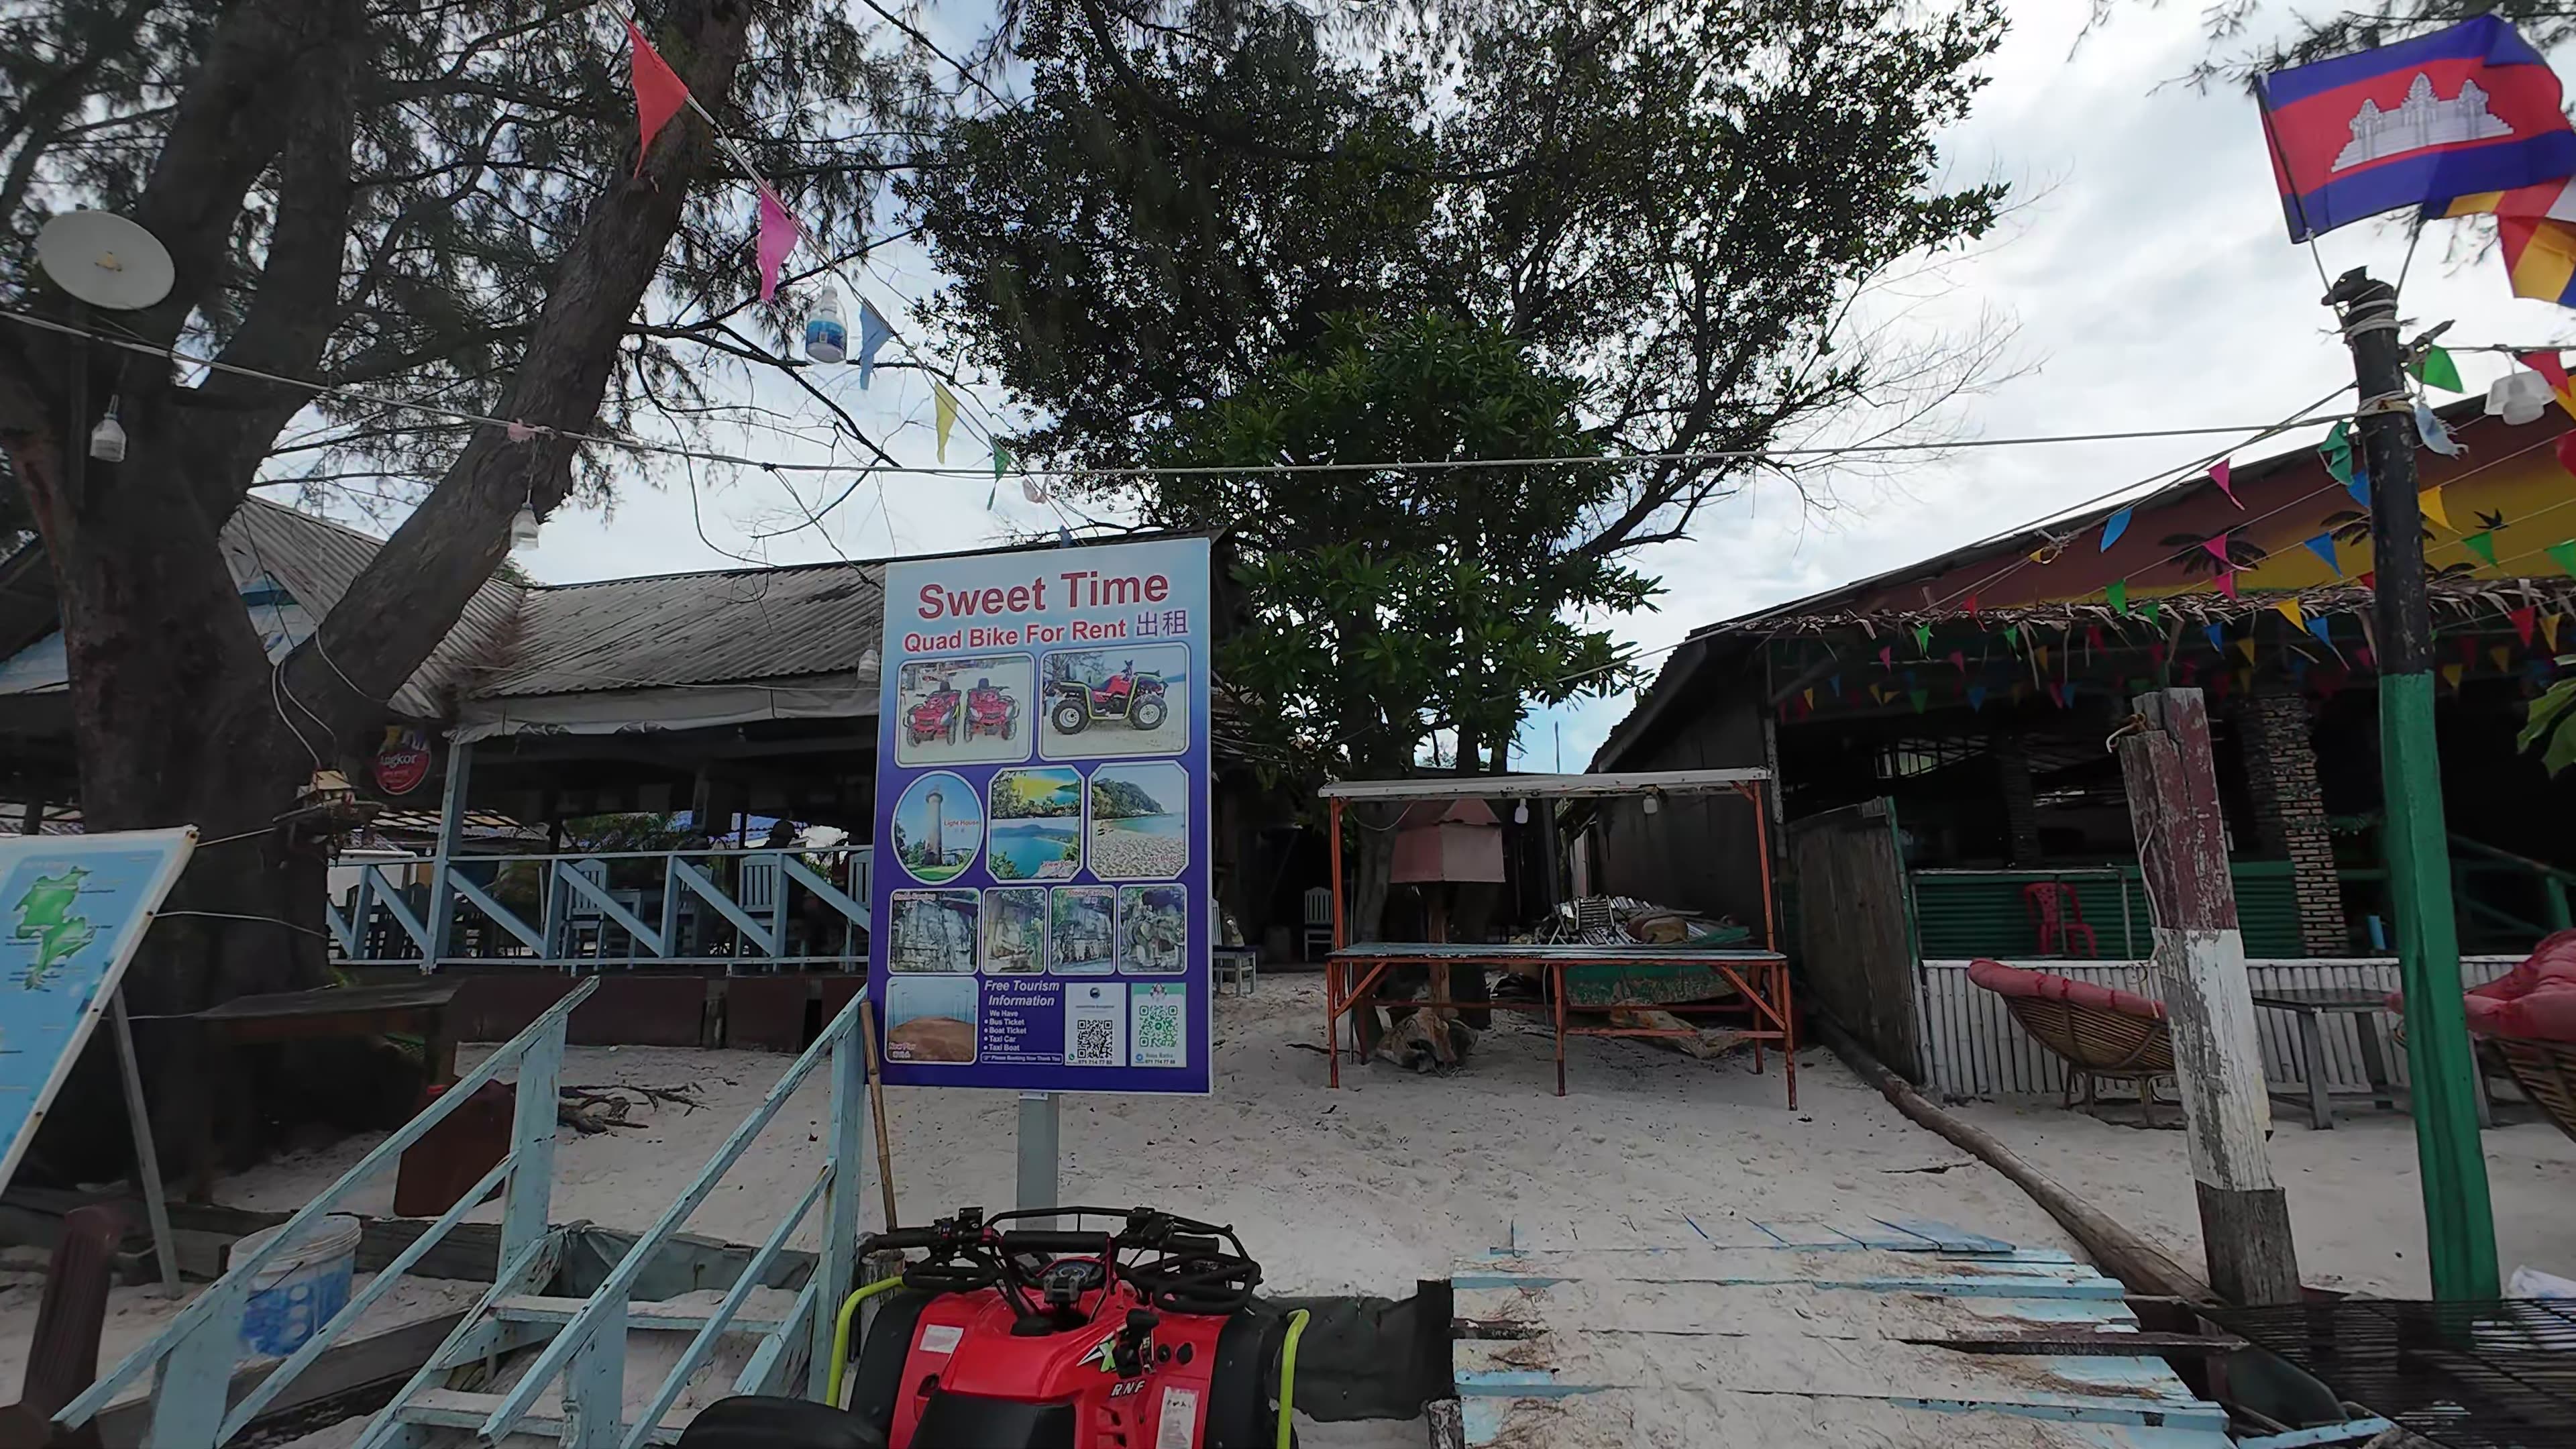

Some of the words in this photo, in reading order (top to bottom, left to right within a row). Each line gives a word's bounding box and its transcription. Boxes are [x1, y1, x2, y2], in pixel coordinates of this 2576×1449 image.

[918, 576, 1046, 619] Sweet
[1061, 571, 1169, 608] Time
[1136, 610, 1189, 638] 出租
[904, 630, 962, 653] Quad
[970, 627, 1018, 648] Bike
[1026, 625, 1065, 644] For
[1073, 619, 1126, 641] Rent
[1068, 890, 1087, 898] Stone
[984, 980, 1010, 991] Free
[1013, 980, 1060, 991] Tourism
[988, 994, 1055, 1006] Information
[1004, 1035, 1017, 1043] Car
[1004, 1044, 1020, 1052] Boat
[1110, 1381, 1146, 1397] RNF
